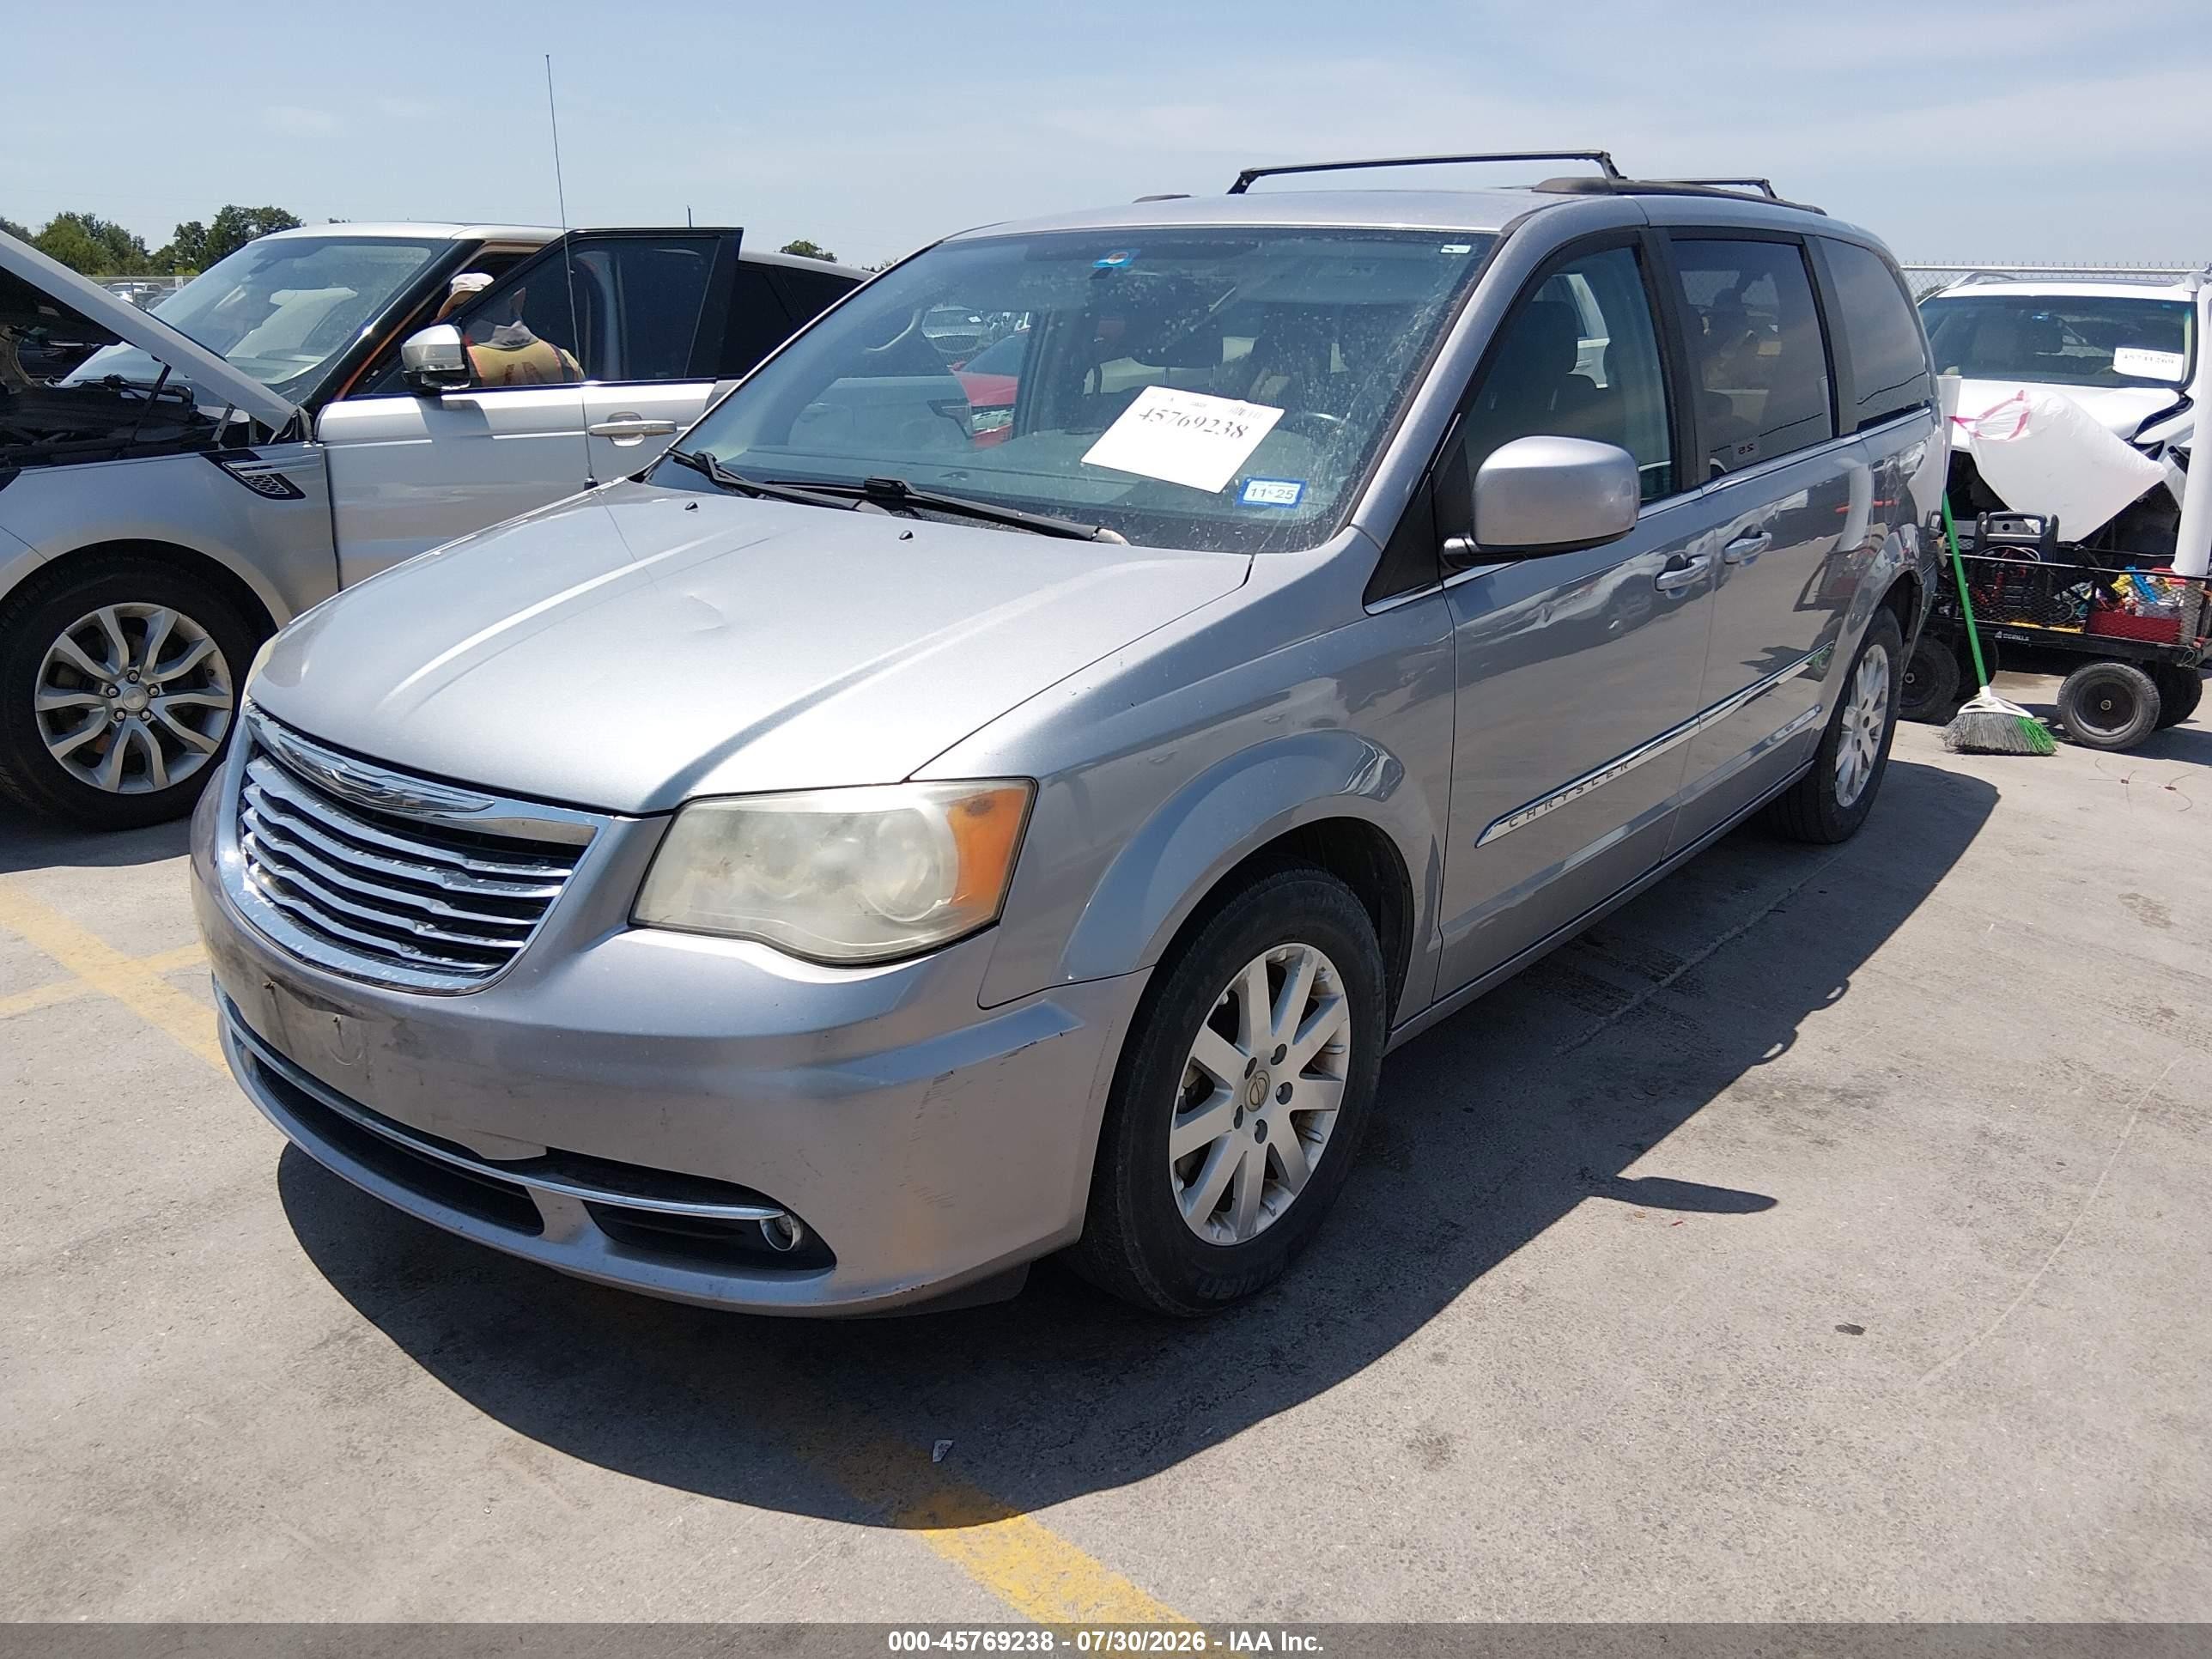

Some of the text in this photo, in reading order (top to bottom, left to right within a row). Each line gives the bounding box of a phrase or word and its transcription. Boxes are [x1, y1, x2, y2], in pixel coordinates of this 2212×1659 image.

[1139, 407, 1249, 438] 45769238
[1251, 488, 1295, 500] 11 25
[1509, 762, 1629, 828] CHRYSLER
